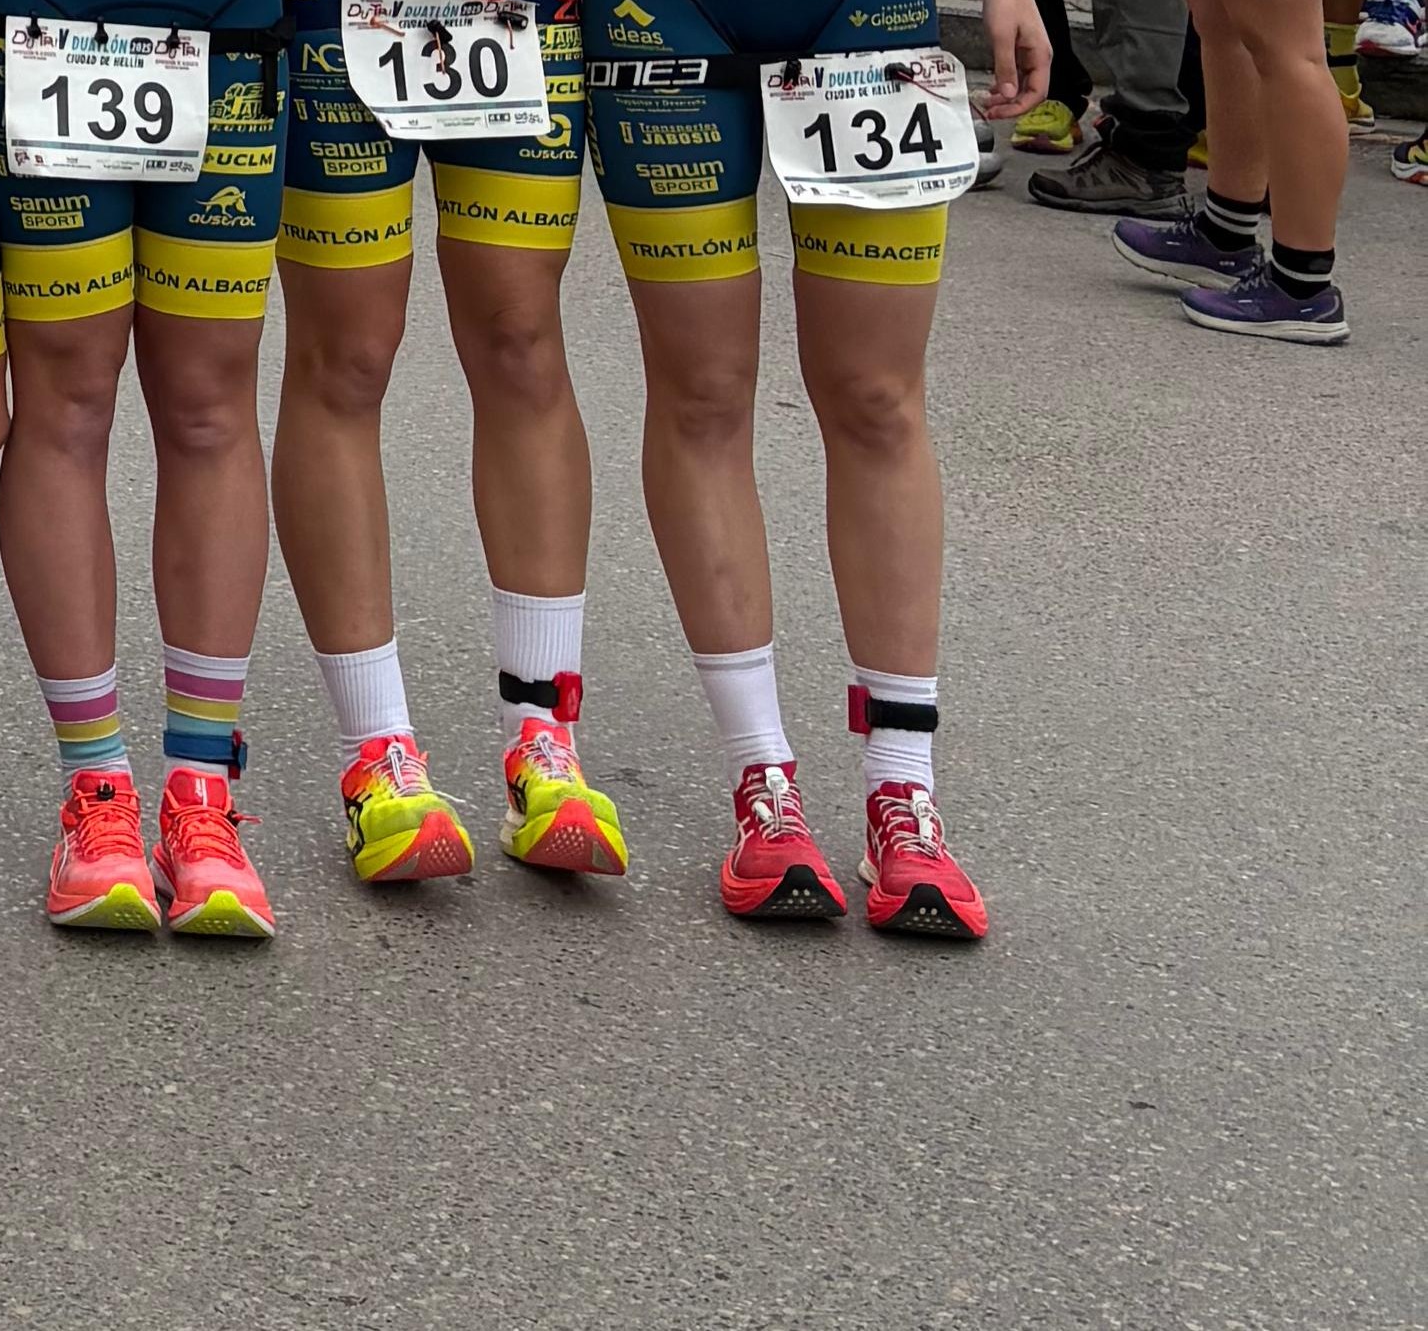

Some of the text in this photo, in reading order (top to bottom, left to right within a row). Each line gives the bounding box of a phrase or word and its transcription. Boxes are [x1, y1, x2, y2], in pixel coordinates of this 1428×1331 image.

[404, 0, 460, 18] DUATLÓN
[58, 28, 154, 56] V 2025
[608, 23, 664, 45] ideas
[66, 53, 97, 65] CIUDAD
[113, 55, 144, 68] HELLÍN
[378, 37, 509, 102] 130
[828, 67, 884, 88] DUATLÓN
[41, 75, 174, 144] 139
[803, 102, 944, 173] 134
[311, 139, 393, 159] sanum
[216, 152, 272, 167] UCLM
[327, 160, 383, 174] SPORT
[636, 159, 725, 179] sanum
[653, 178, 714, 194] SPORT
[10, 194, 91, 213] sanum
[283, 223, 379, 246] TRIATLÓN
[629, 239, 732, 258] TRIATLÓN
[833, 242, 941, 262] ALBACETE
